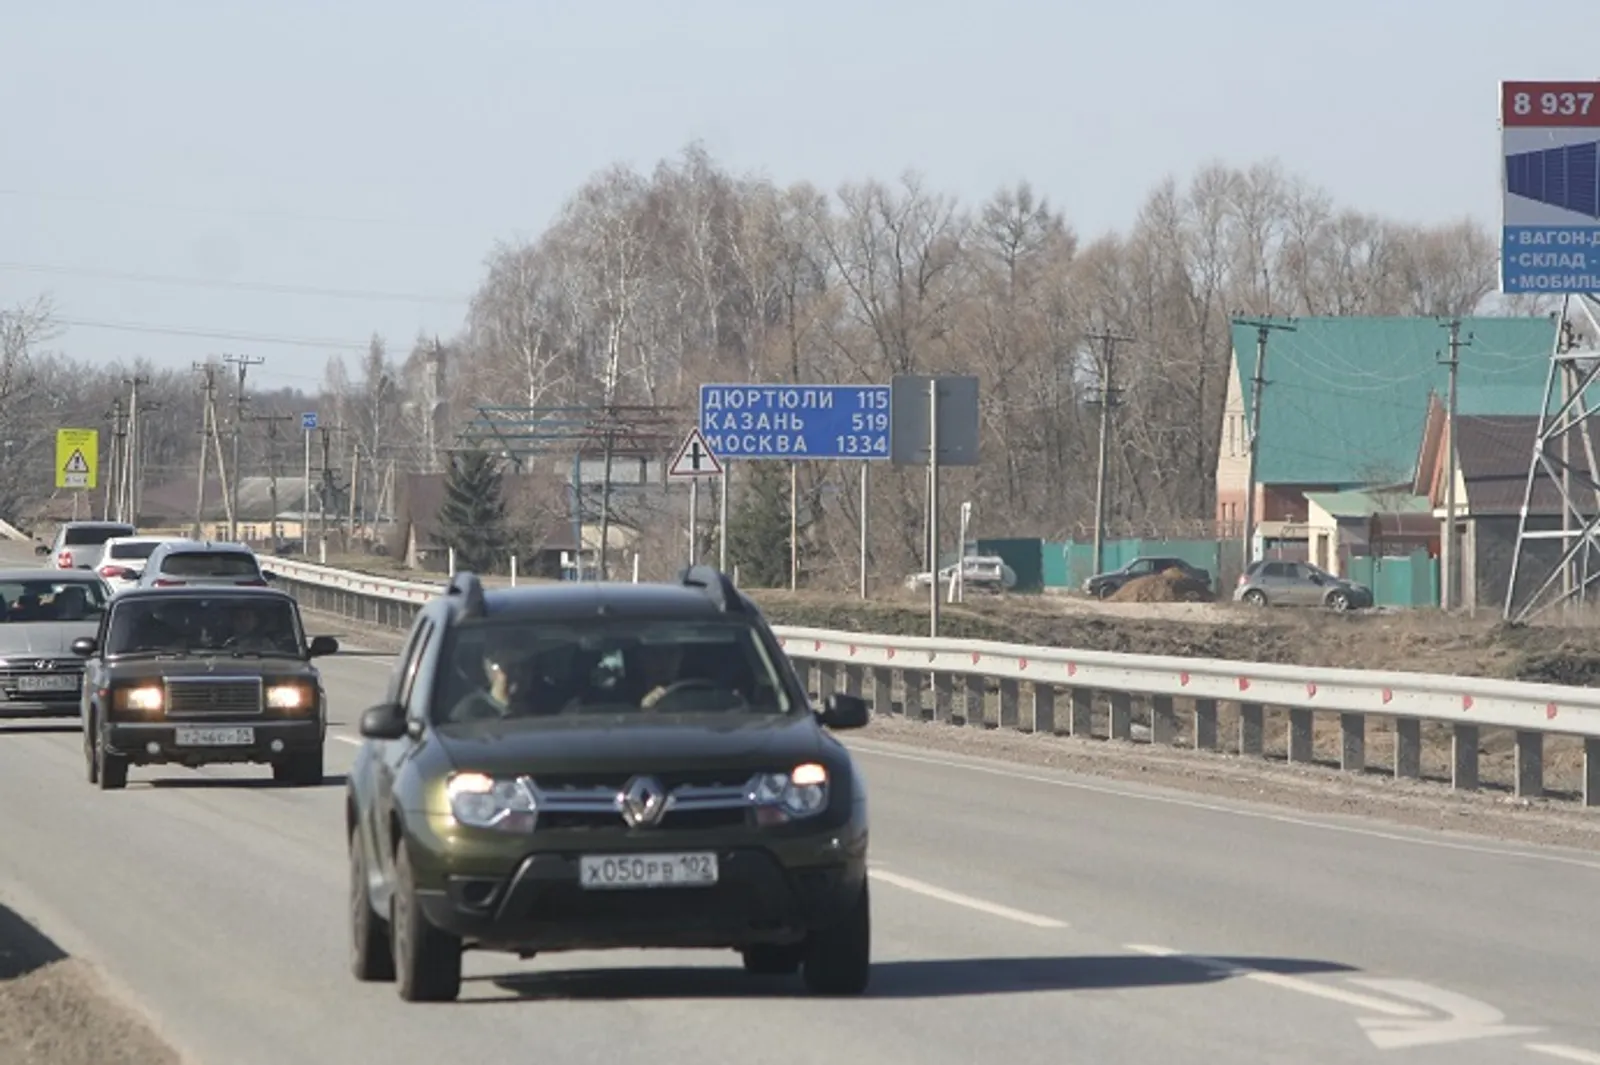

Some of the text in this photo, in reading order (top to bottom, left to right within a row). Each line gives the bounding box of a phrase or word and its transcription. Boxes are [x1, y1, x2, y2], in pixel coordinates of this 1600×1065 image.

[1514, 92, 1594, 115] 8 937
[1520, 252, 1586, 270] СКЛАД
[705, 390, 887, 410] ДЮРТЮЛИ 115
[705, 412, 887, 431] КАЗАНЬ 519
[704, 435, 886, 453] МОСКВА 1334
